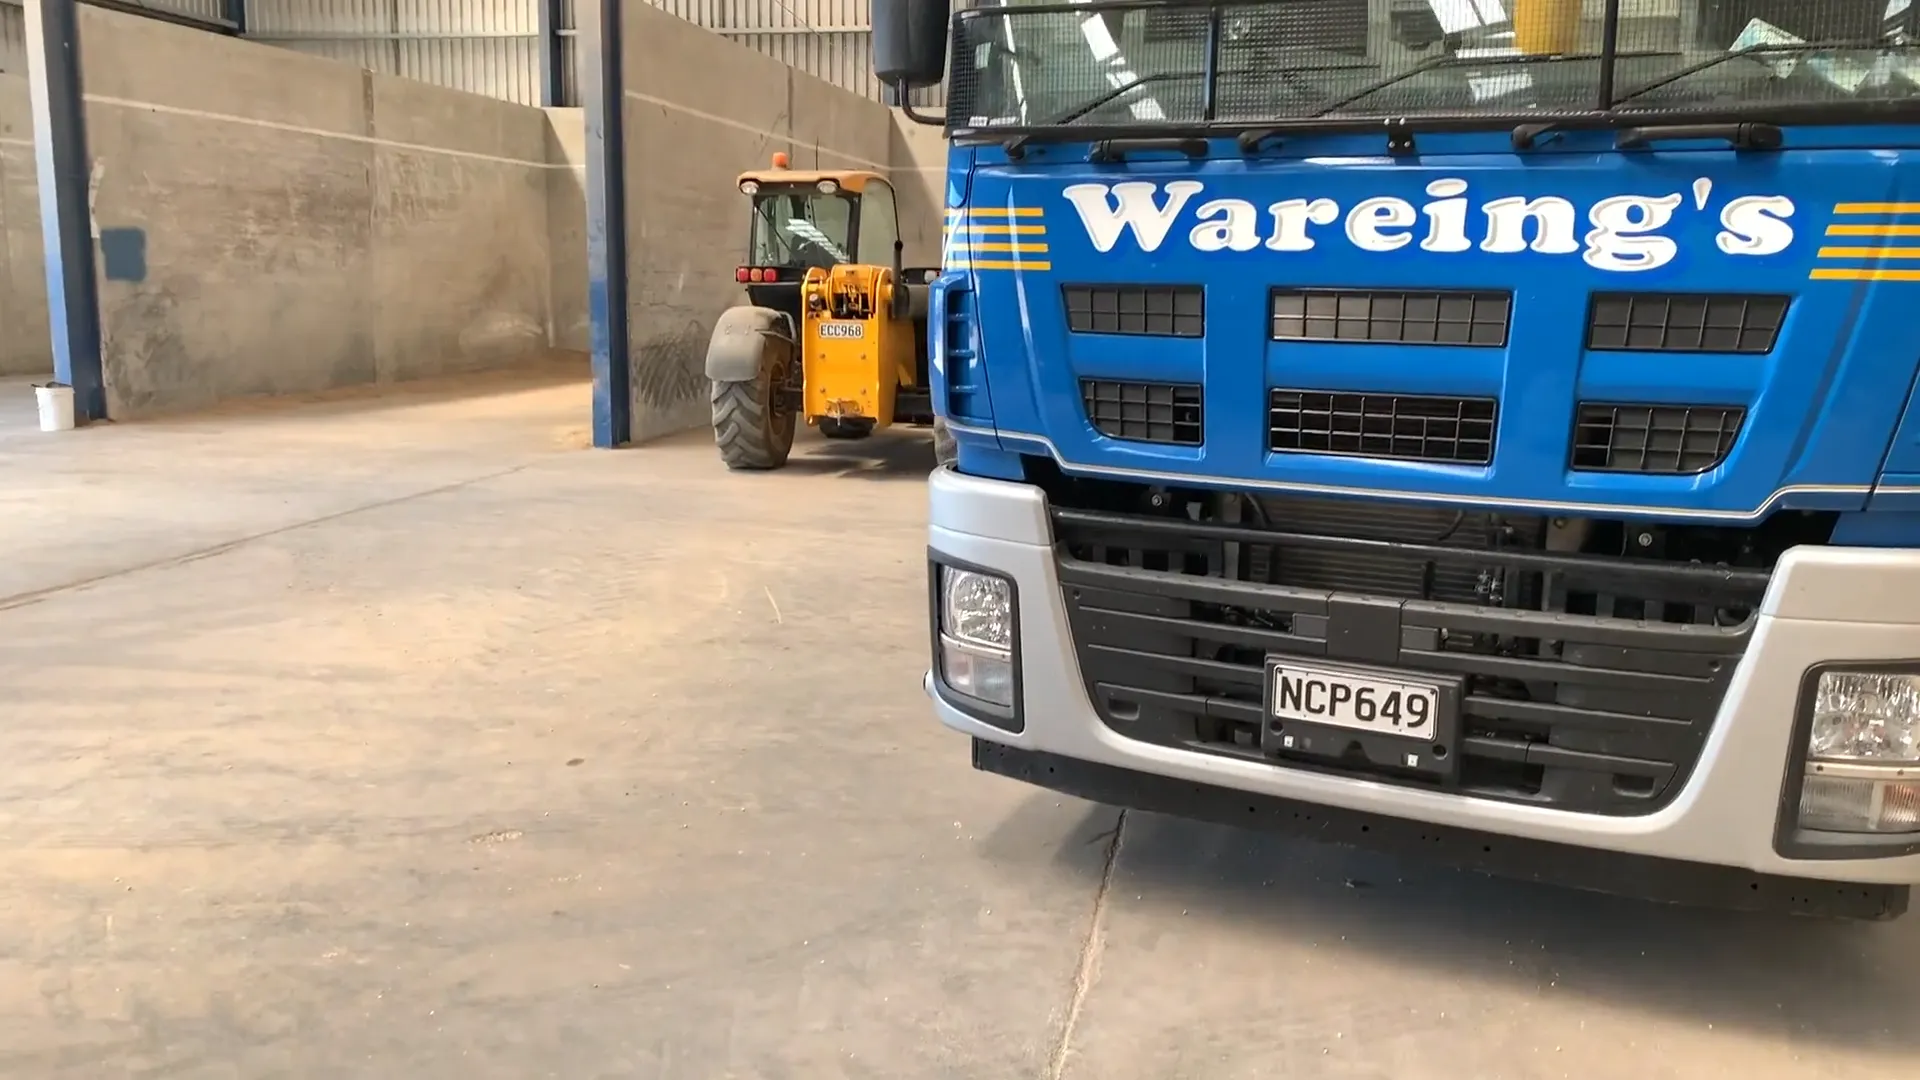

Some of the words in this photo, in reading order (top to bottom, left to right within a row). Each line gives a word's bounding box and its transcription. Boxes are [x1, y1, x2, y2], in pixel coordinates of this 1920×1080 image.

[1062, 177, 1796, 272] Wareing's
[820, 324, 862, 337] ECC968
[1279, 675, 1430, 728] NCP649
